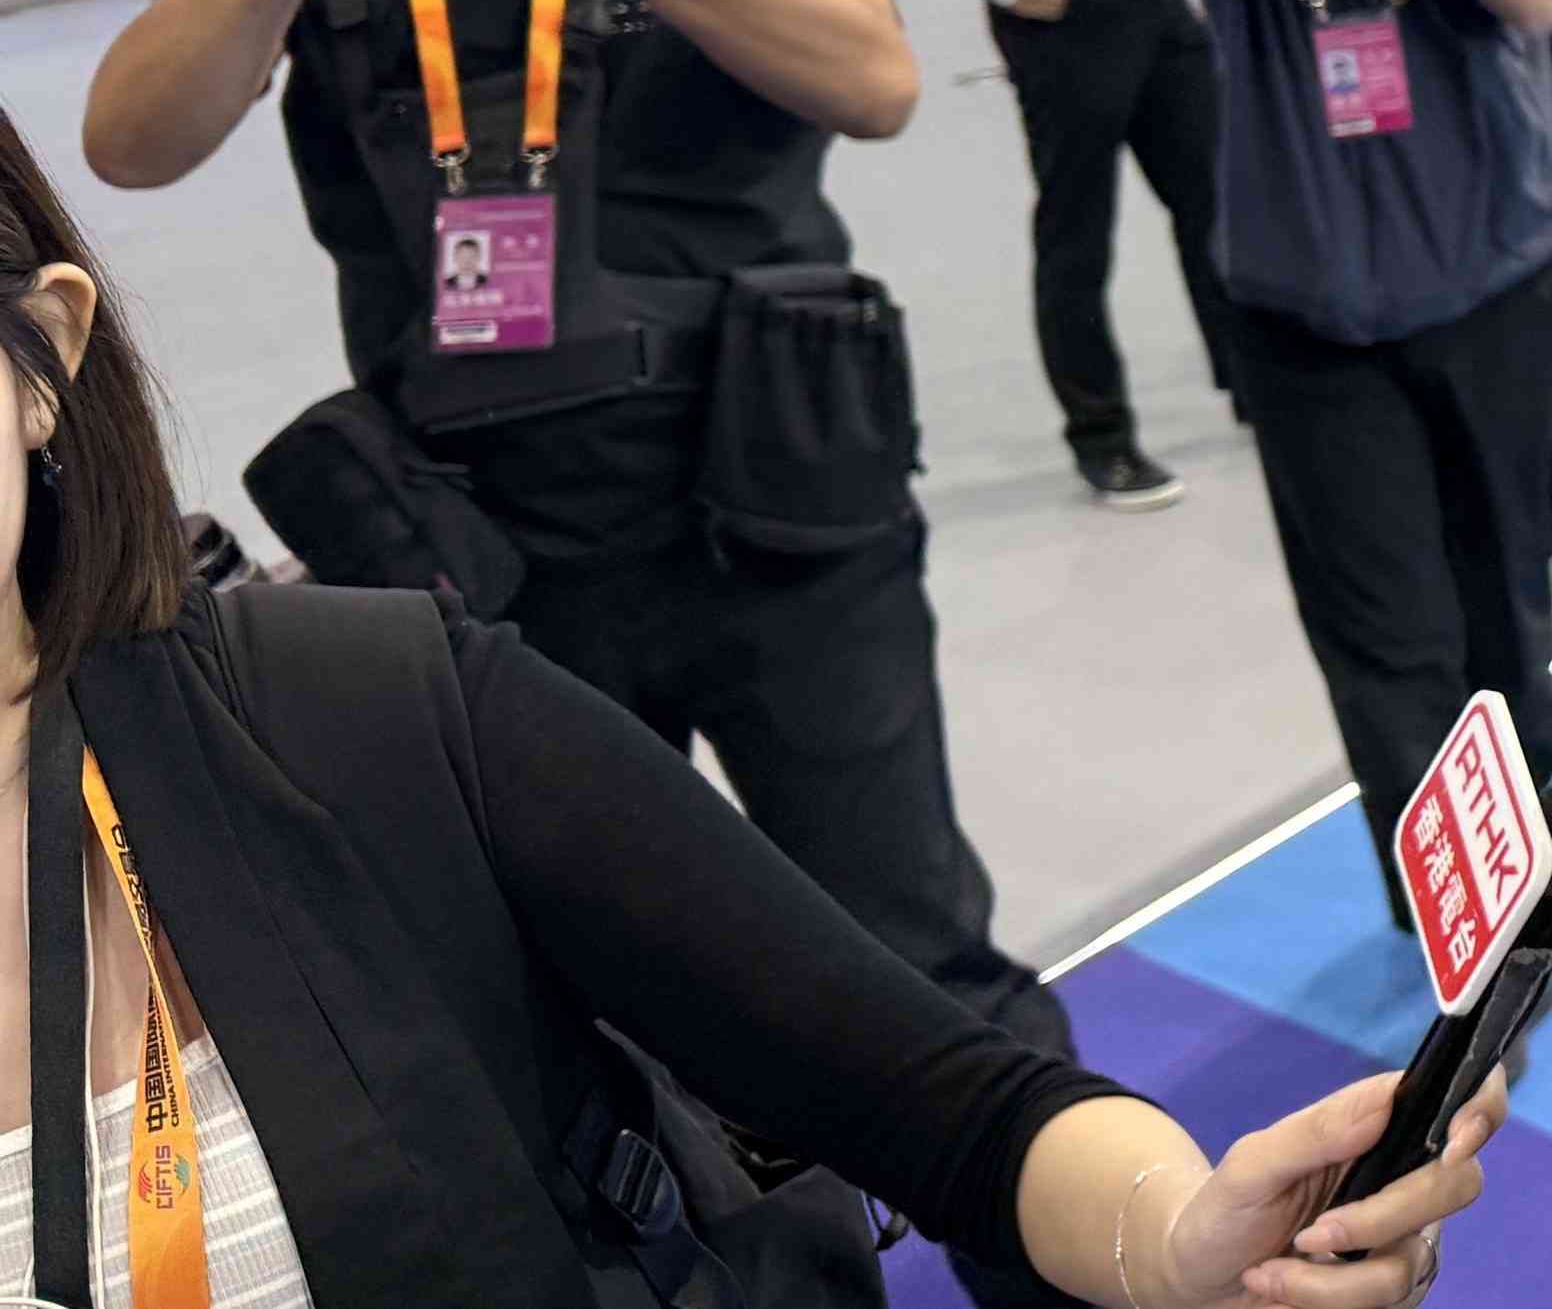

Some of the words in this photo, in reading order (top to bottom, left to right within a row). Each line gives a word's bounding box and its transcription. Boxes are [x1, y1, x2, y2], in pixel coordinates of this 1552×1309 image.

[1455, 732, 1519, 904] RTHK
[1414, 793, 1477, 975] 香港電台
[167, 1086, 179, 1128] CHINA
[156, 1144, 174, 1209] CIFTIS
